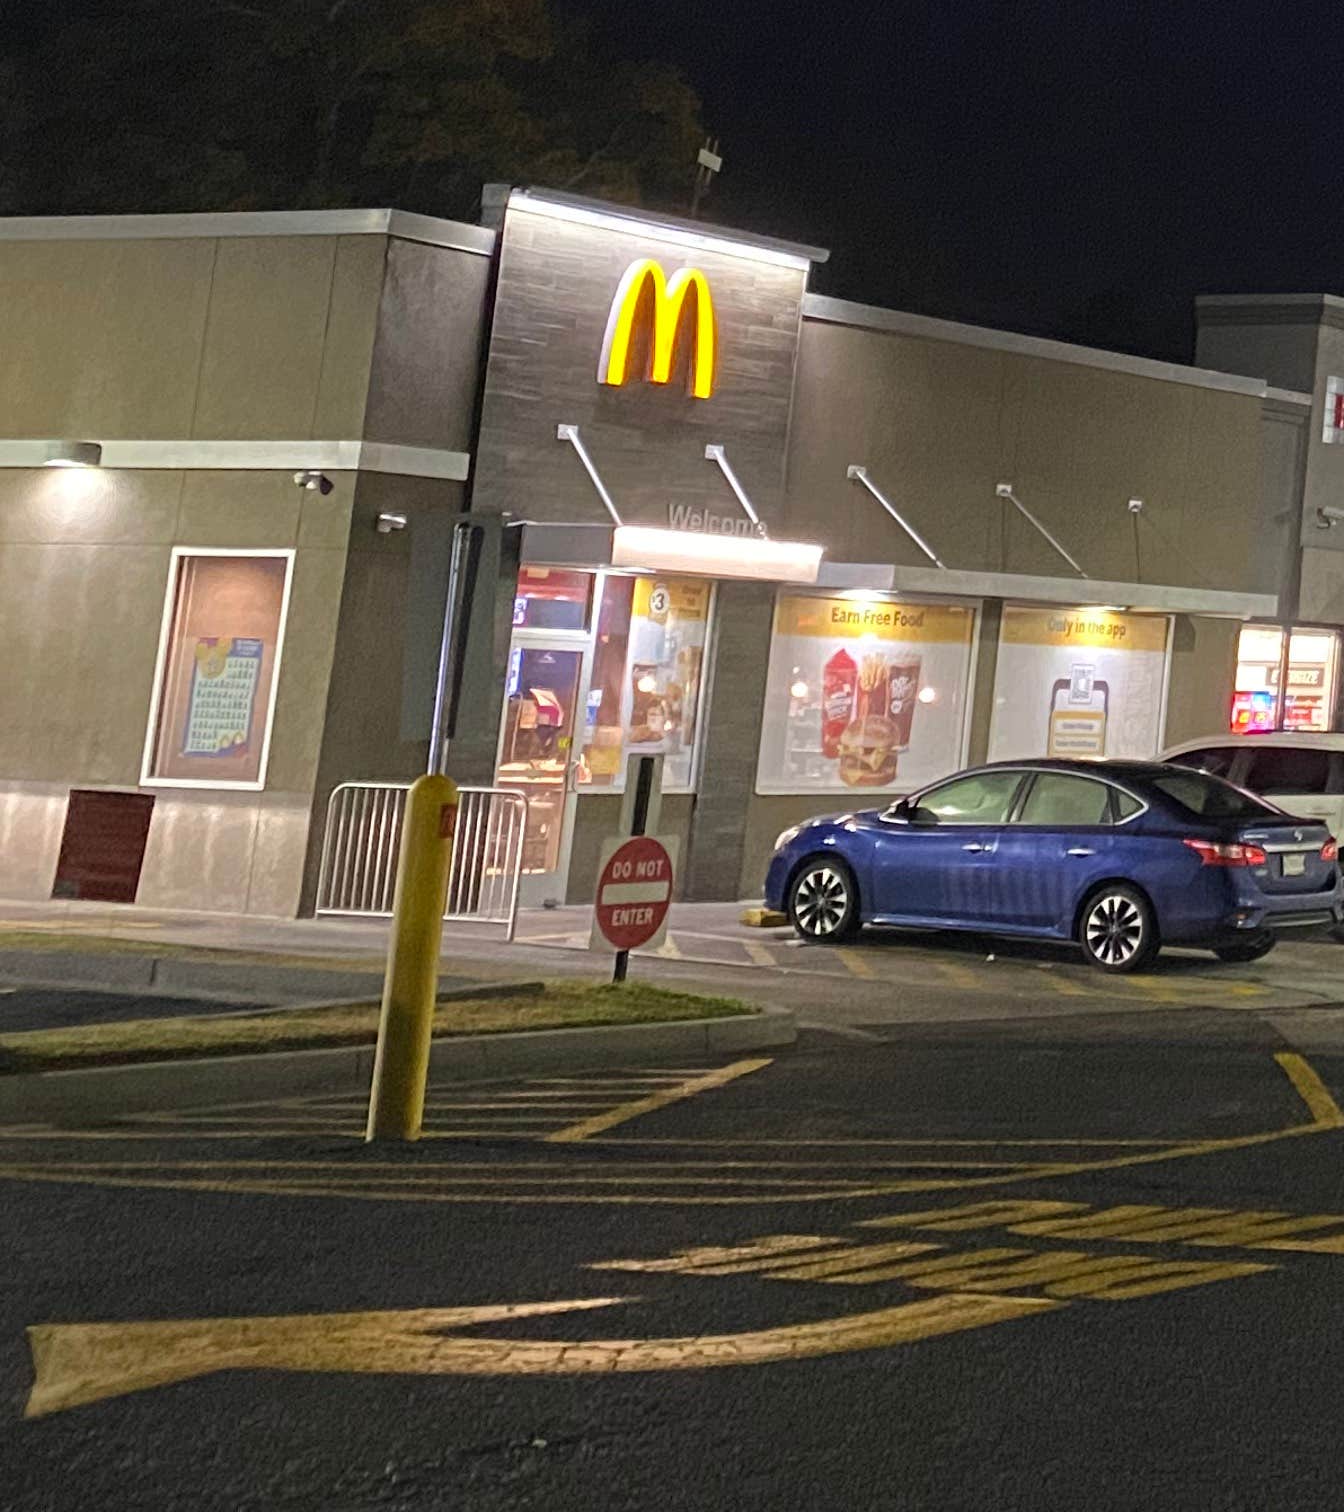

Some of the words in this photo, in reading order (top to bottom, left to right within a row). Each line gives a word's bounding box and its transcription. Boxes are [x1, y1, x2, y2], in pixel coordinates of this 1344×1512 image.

[831, 607, 860, 624] Earn
[863, 609, 891, 625] Free
[893, 610, 925, 627] Food
[1075, 617, 1086, 633] in
[1106, 624, 1127, 640] app
[611, 861, 632, 879] DO
[636, 860, 664, 878] NOT
[611, 907, 654, 927] ENTER
